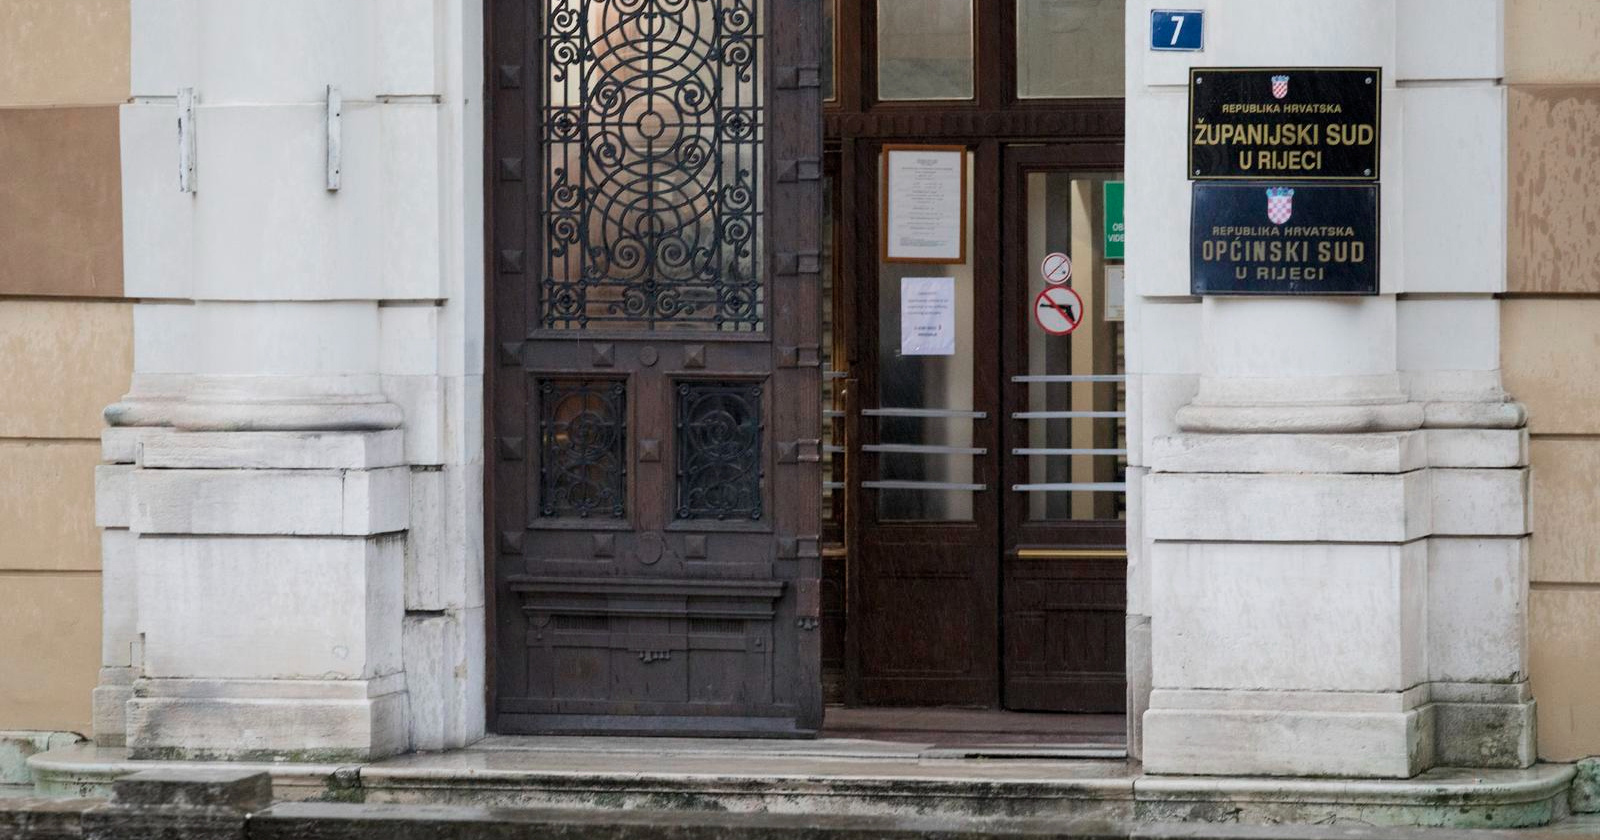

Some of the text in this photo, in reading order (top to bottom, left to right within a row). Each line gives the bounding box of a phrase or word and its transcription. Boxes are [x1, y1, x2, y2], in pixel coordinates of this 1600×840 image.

[1170, 15, 1185, 46] 7
[1222, 103, 1342, 113] REPUBLIKA HRVATSKA
[1194, 118, 1374, 146] ŽUPANIJSKI SUD
[1239, 150, 1322, 170] U RIJECI
[1212, 226, 1355, 237] REPUBLIKA HRVATSKA
[1202, 237, 1364, 263] OPĆINSKI SUD
[1236, 266, 1325, 281] U RIJECI
